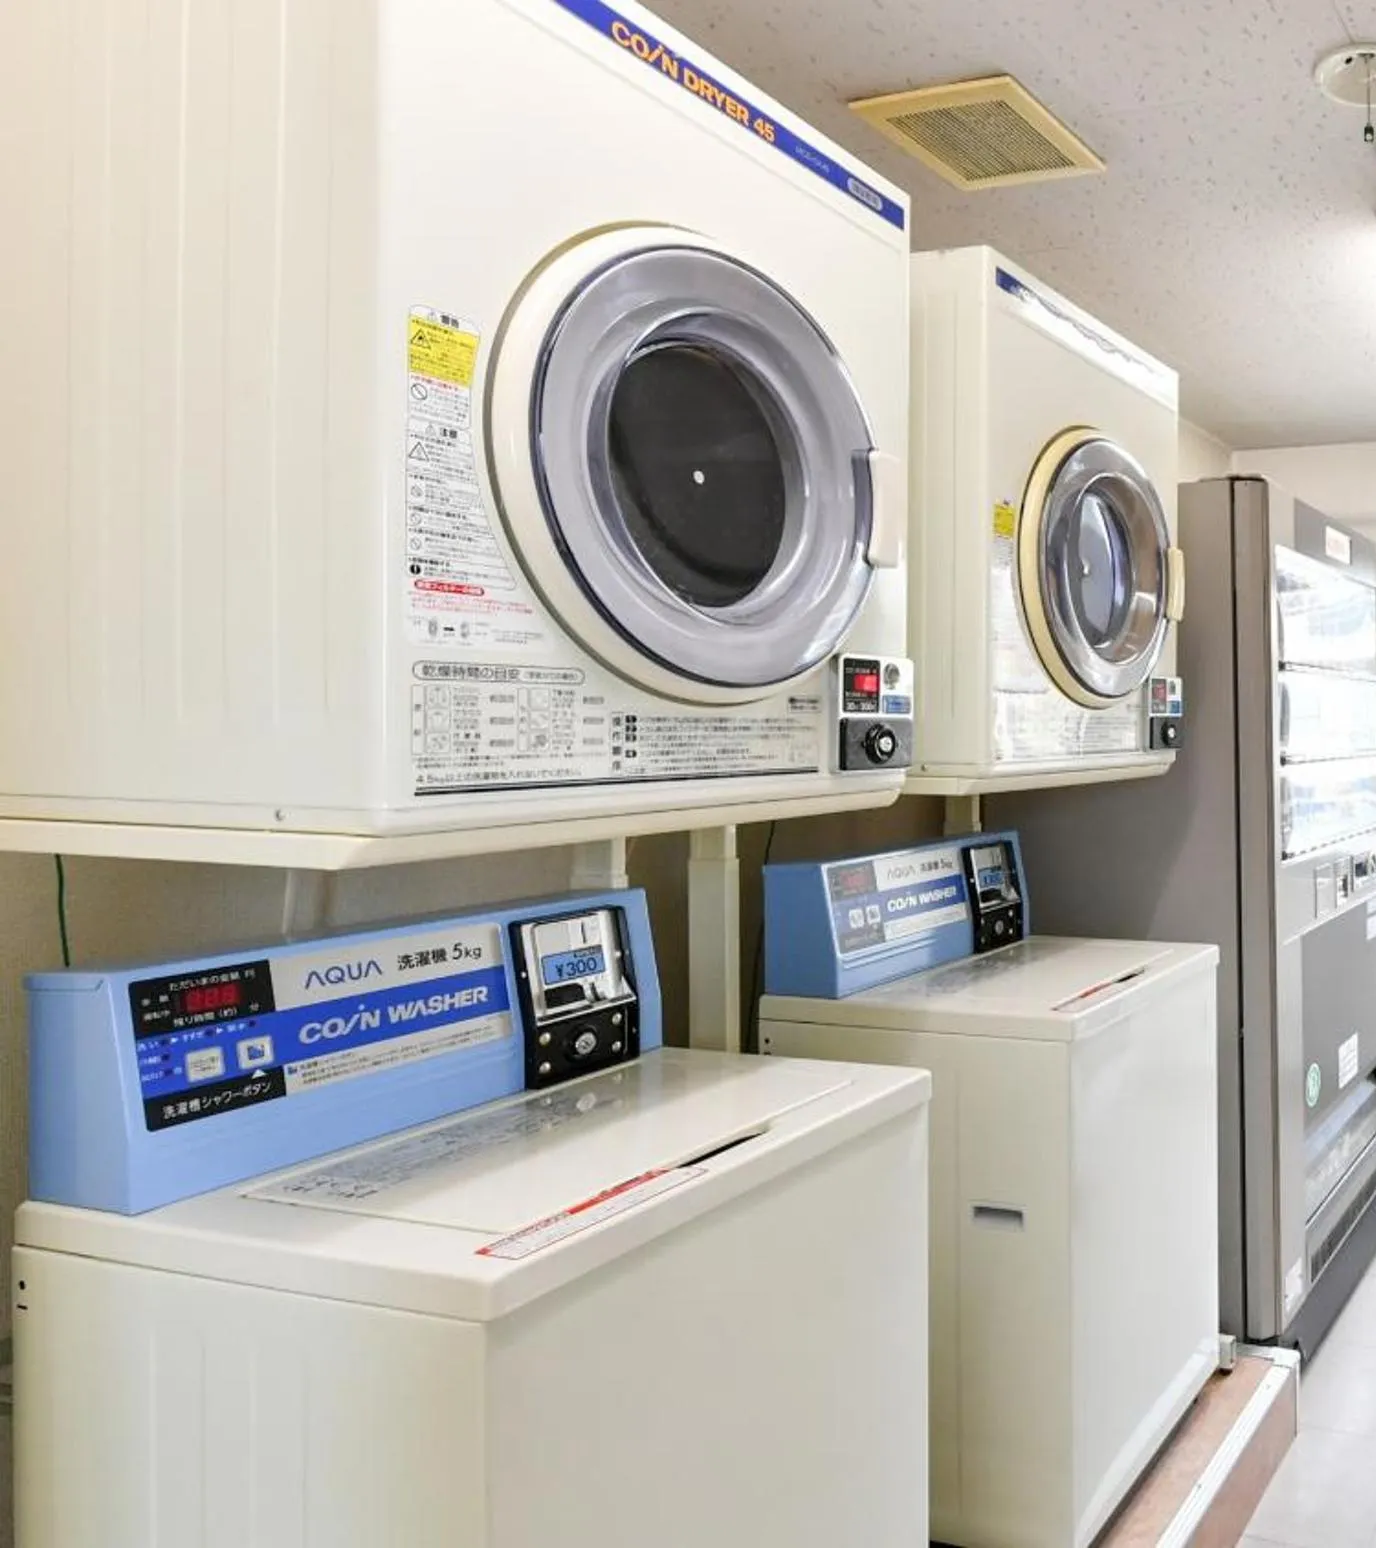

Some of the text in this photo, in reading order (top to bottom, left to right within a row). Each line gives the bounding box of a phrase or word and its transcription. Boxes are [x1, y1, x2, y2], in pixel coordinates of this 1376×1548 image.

[683, 66, 750, 127] DRYER
[752, 117, 776, 143] 45
[421, 665, 521, 680] 乾燥時間の目安
[886, 862, 916, 880] AQUA
[304, 942, 482, 990] AQUA 洗濯機 5kg
[555, 957, 598, 977] ¥300
[387, 986, 489, 1026] WASHER
[162, 1080, 272, 1119] 洗濯槽シャワーボタン
